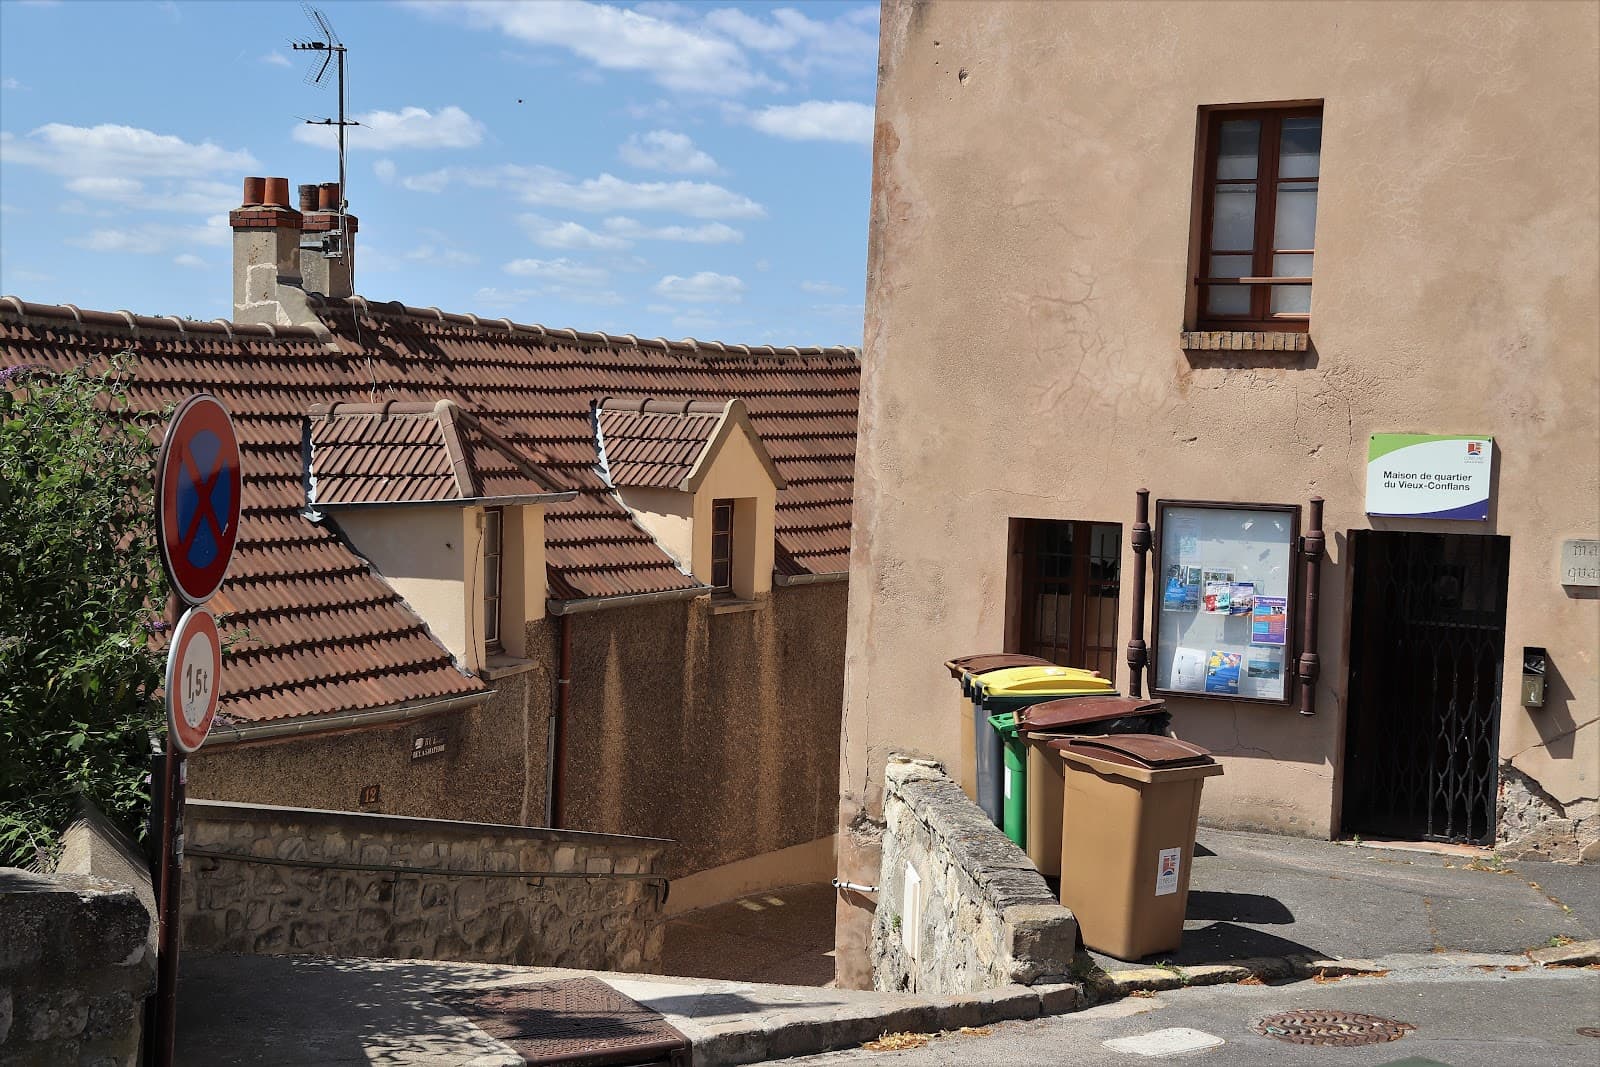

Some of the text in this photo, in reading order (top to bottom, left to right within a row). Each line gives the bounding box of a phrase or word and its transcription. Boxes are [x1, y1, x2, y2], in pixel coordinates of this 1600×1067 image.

[1383, 471, 1472, 482] Maison de quartier
[1384, 481, 1471, 491] du Vieux-Conflans
